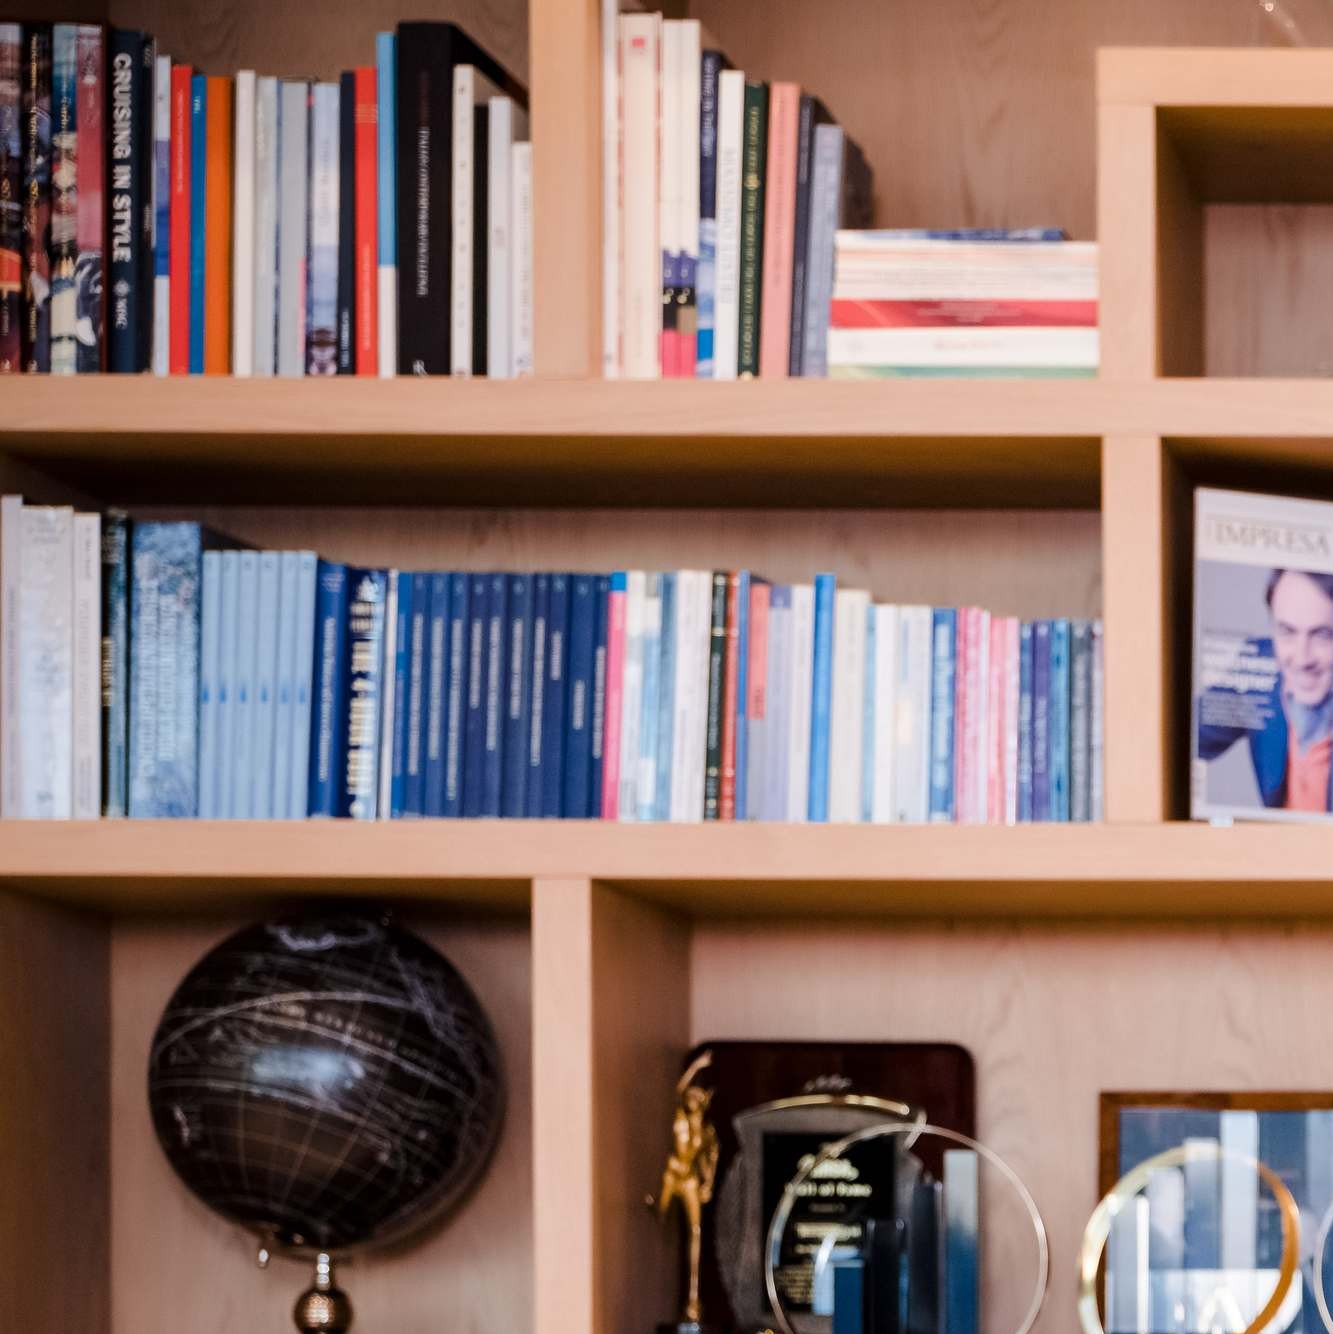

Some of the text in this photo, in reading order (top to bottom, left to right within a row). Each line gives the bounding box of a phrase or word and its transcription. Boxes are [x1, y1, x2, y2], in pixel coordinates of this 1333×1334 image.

[112, 53, 132, 262] CRUISING IN STYLE
